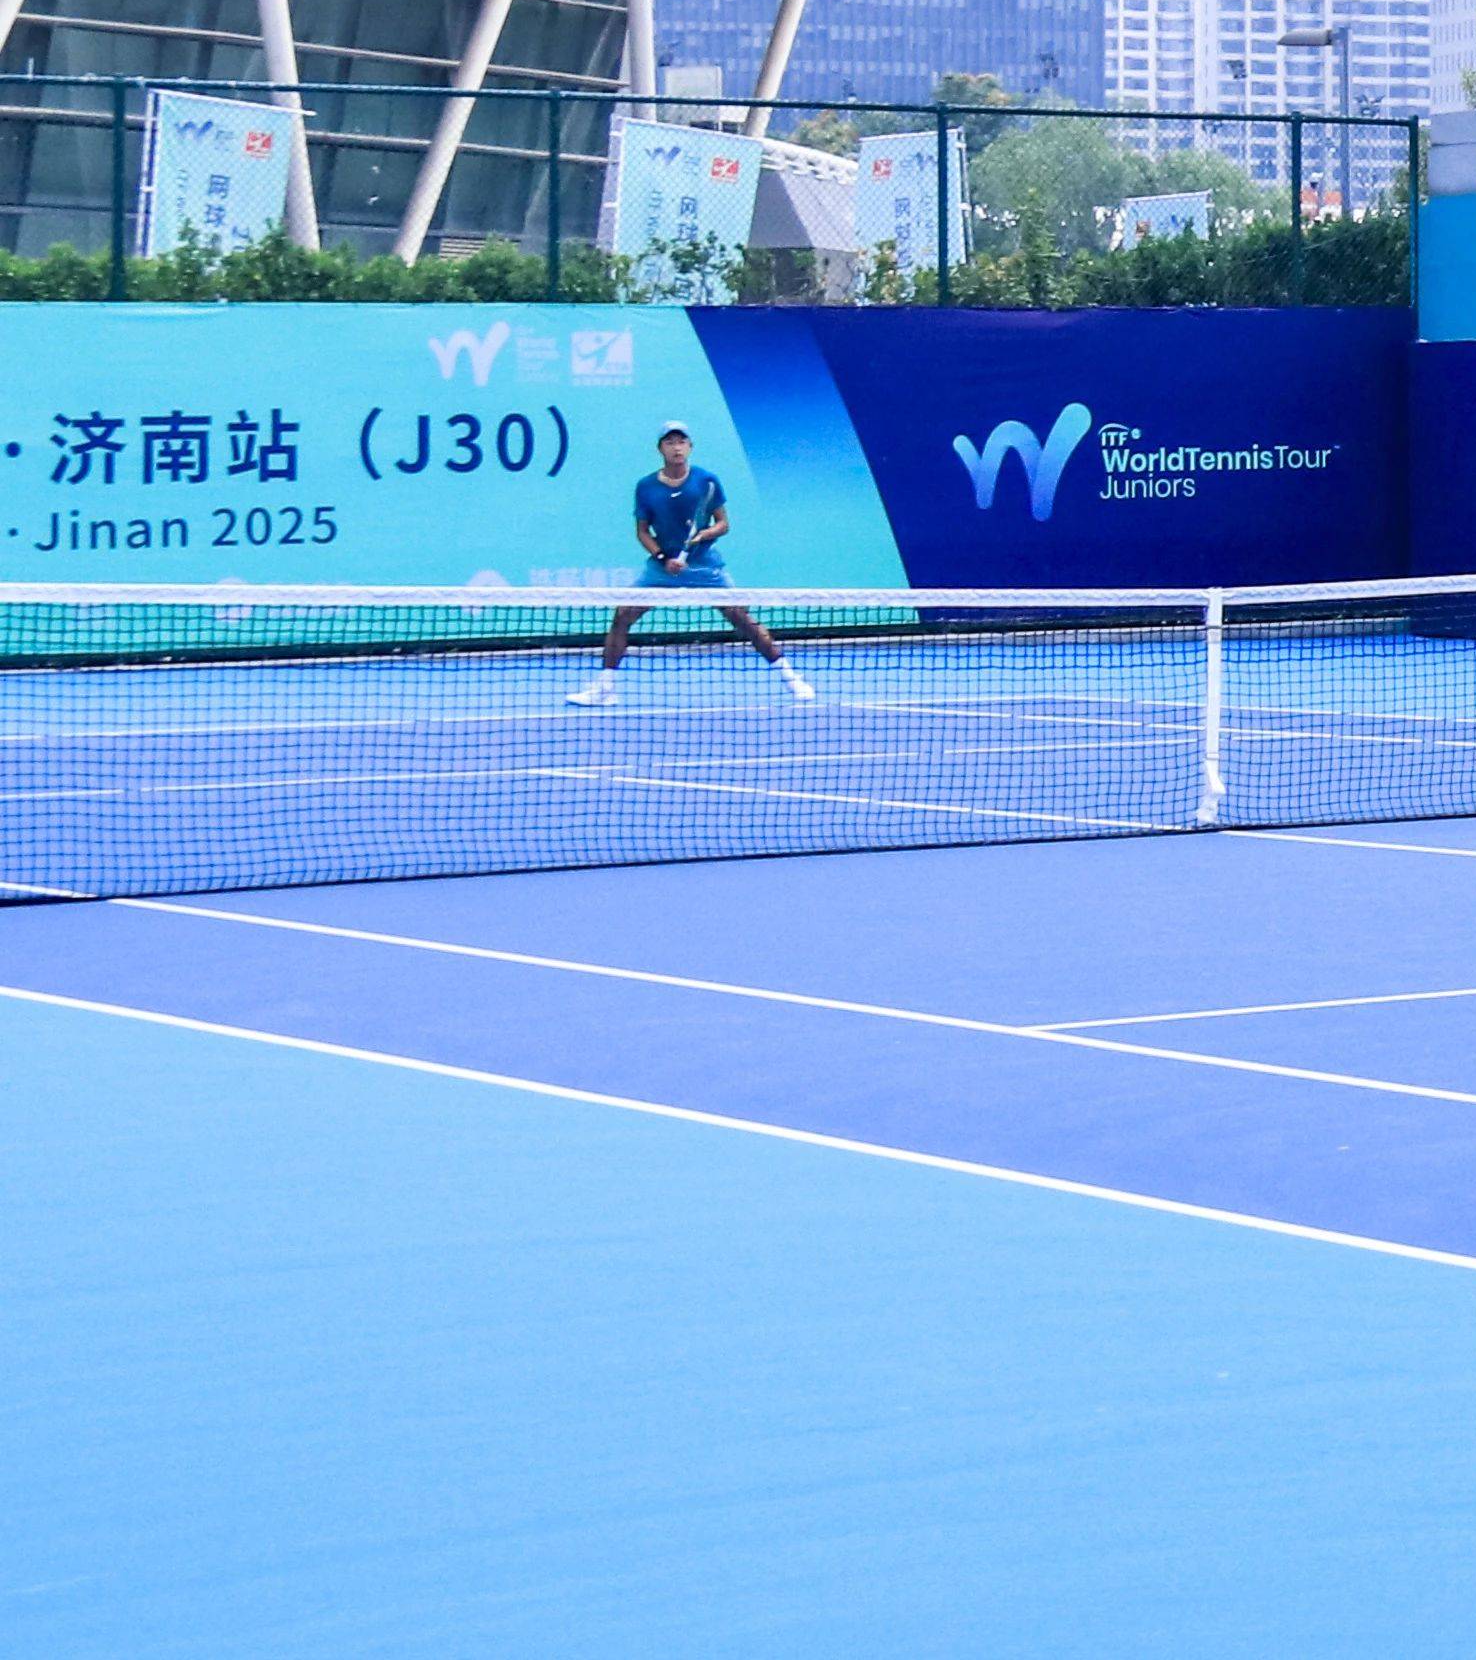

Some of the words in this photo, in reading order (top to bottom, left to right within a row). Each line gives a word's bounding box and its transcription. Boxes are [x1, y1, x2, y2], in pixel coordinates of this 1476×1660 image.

[1100, 474, 1196, 500] Juniors
[34, 509, 190, 551] Jinan
[211, 506, 339, 546] 2025
